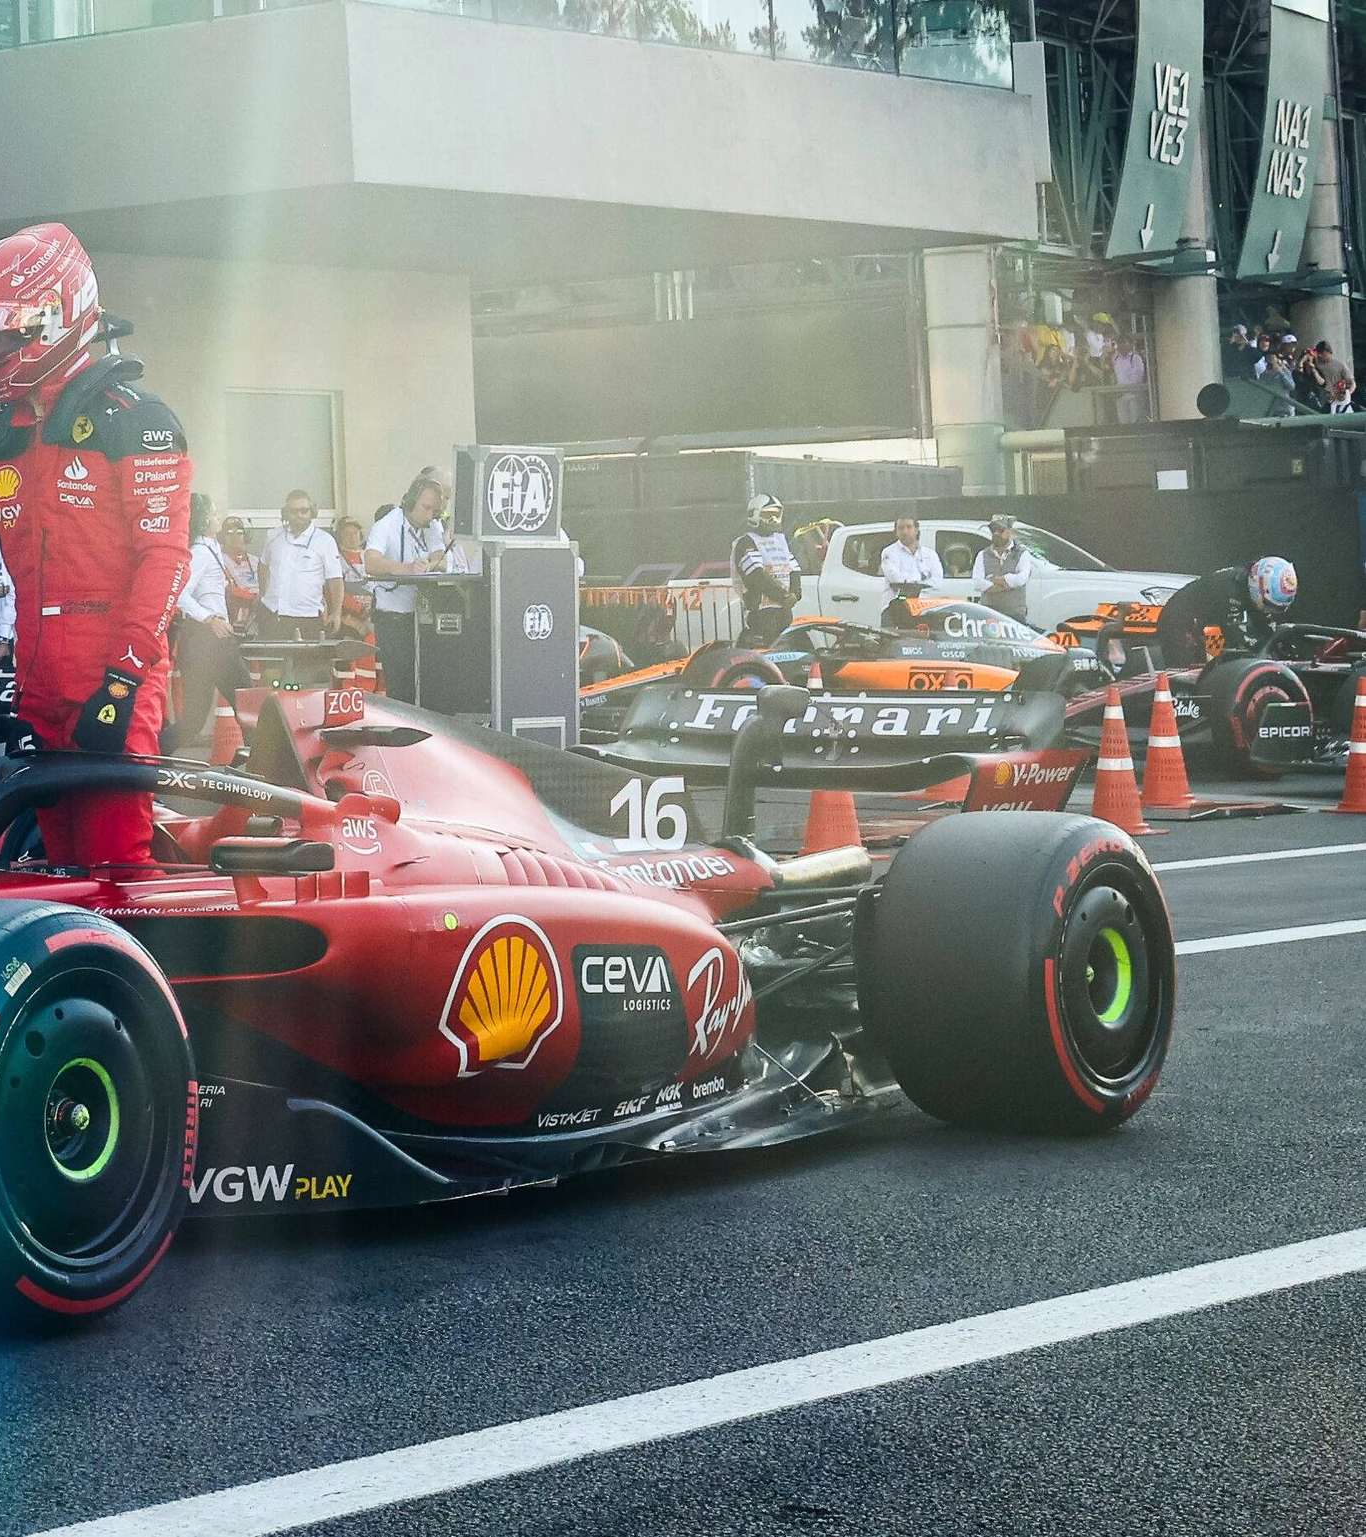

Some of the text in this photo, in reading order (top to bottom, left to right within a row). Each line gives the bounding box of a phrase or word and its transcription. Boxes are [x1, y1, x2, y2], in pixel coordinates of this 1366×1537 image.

[1153, 61, 1190, 119] VE1
[1274, 97, 1312, 150] NA1
[1149, 109, 1189, 167] VE3
[1266, 148, 1308, 200] NA3
[142, 430, 174, 442] aws
[133, 457, 179, 467] Bitdefender
[56, 479, 97, 491] Santander
[1013, 763, 1076, 787] V-Power
[201, 779, 273, 802] TECHNOLOGY
[610, 776, 688, 852] 16
[341, 816, 379, 840] aws
[622, 999, 672, 1012] LOGISTICS
[655, 1081, 684, 1105] NGK
[692, 1076, 726, 1100] brembo
[613, 1095, 651, 1118] SKF
[188, 1163, 353, 1204] VGW PLAY
